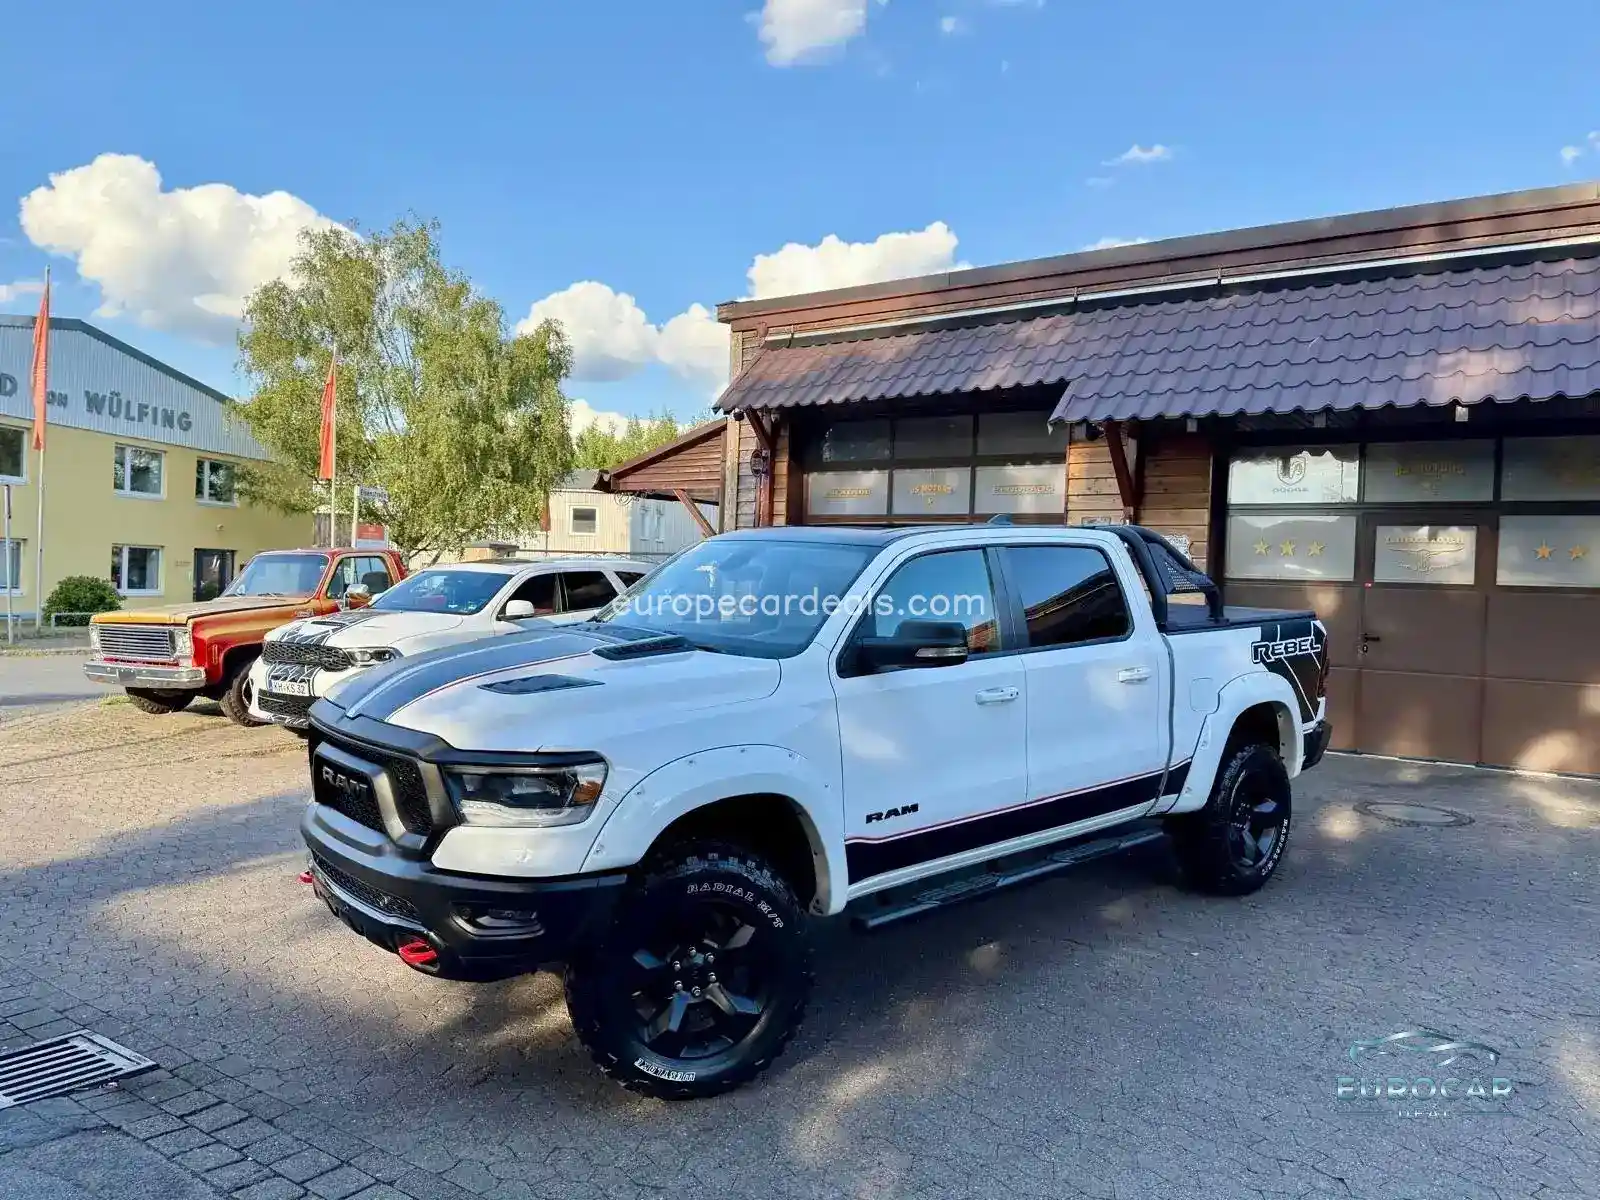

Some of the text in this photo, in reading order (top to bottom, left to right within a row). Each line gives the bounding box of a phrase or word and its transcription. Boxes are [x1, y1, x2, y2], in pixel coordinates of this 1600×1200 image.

[85, 390, 193, 431] WÜLFING
[1250, 636, 1321, 663] REBEL
[322, 765, 368, 798] RAM
[865, 802, 919, 824] RAM
[686, 882, 784, 928] RADIAL M/T
